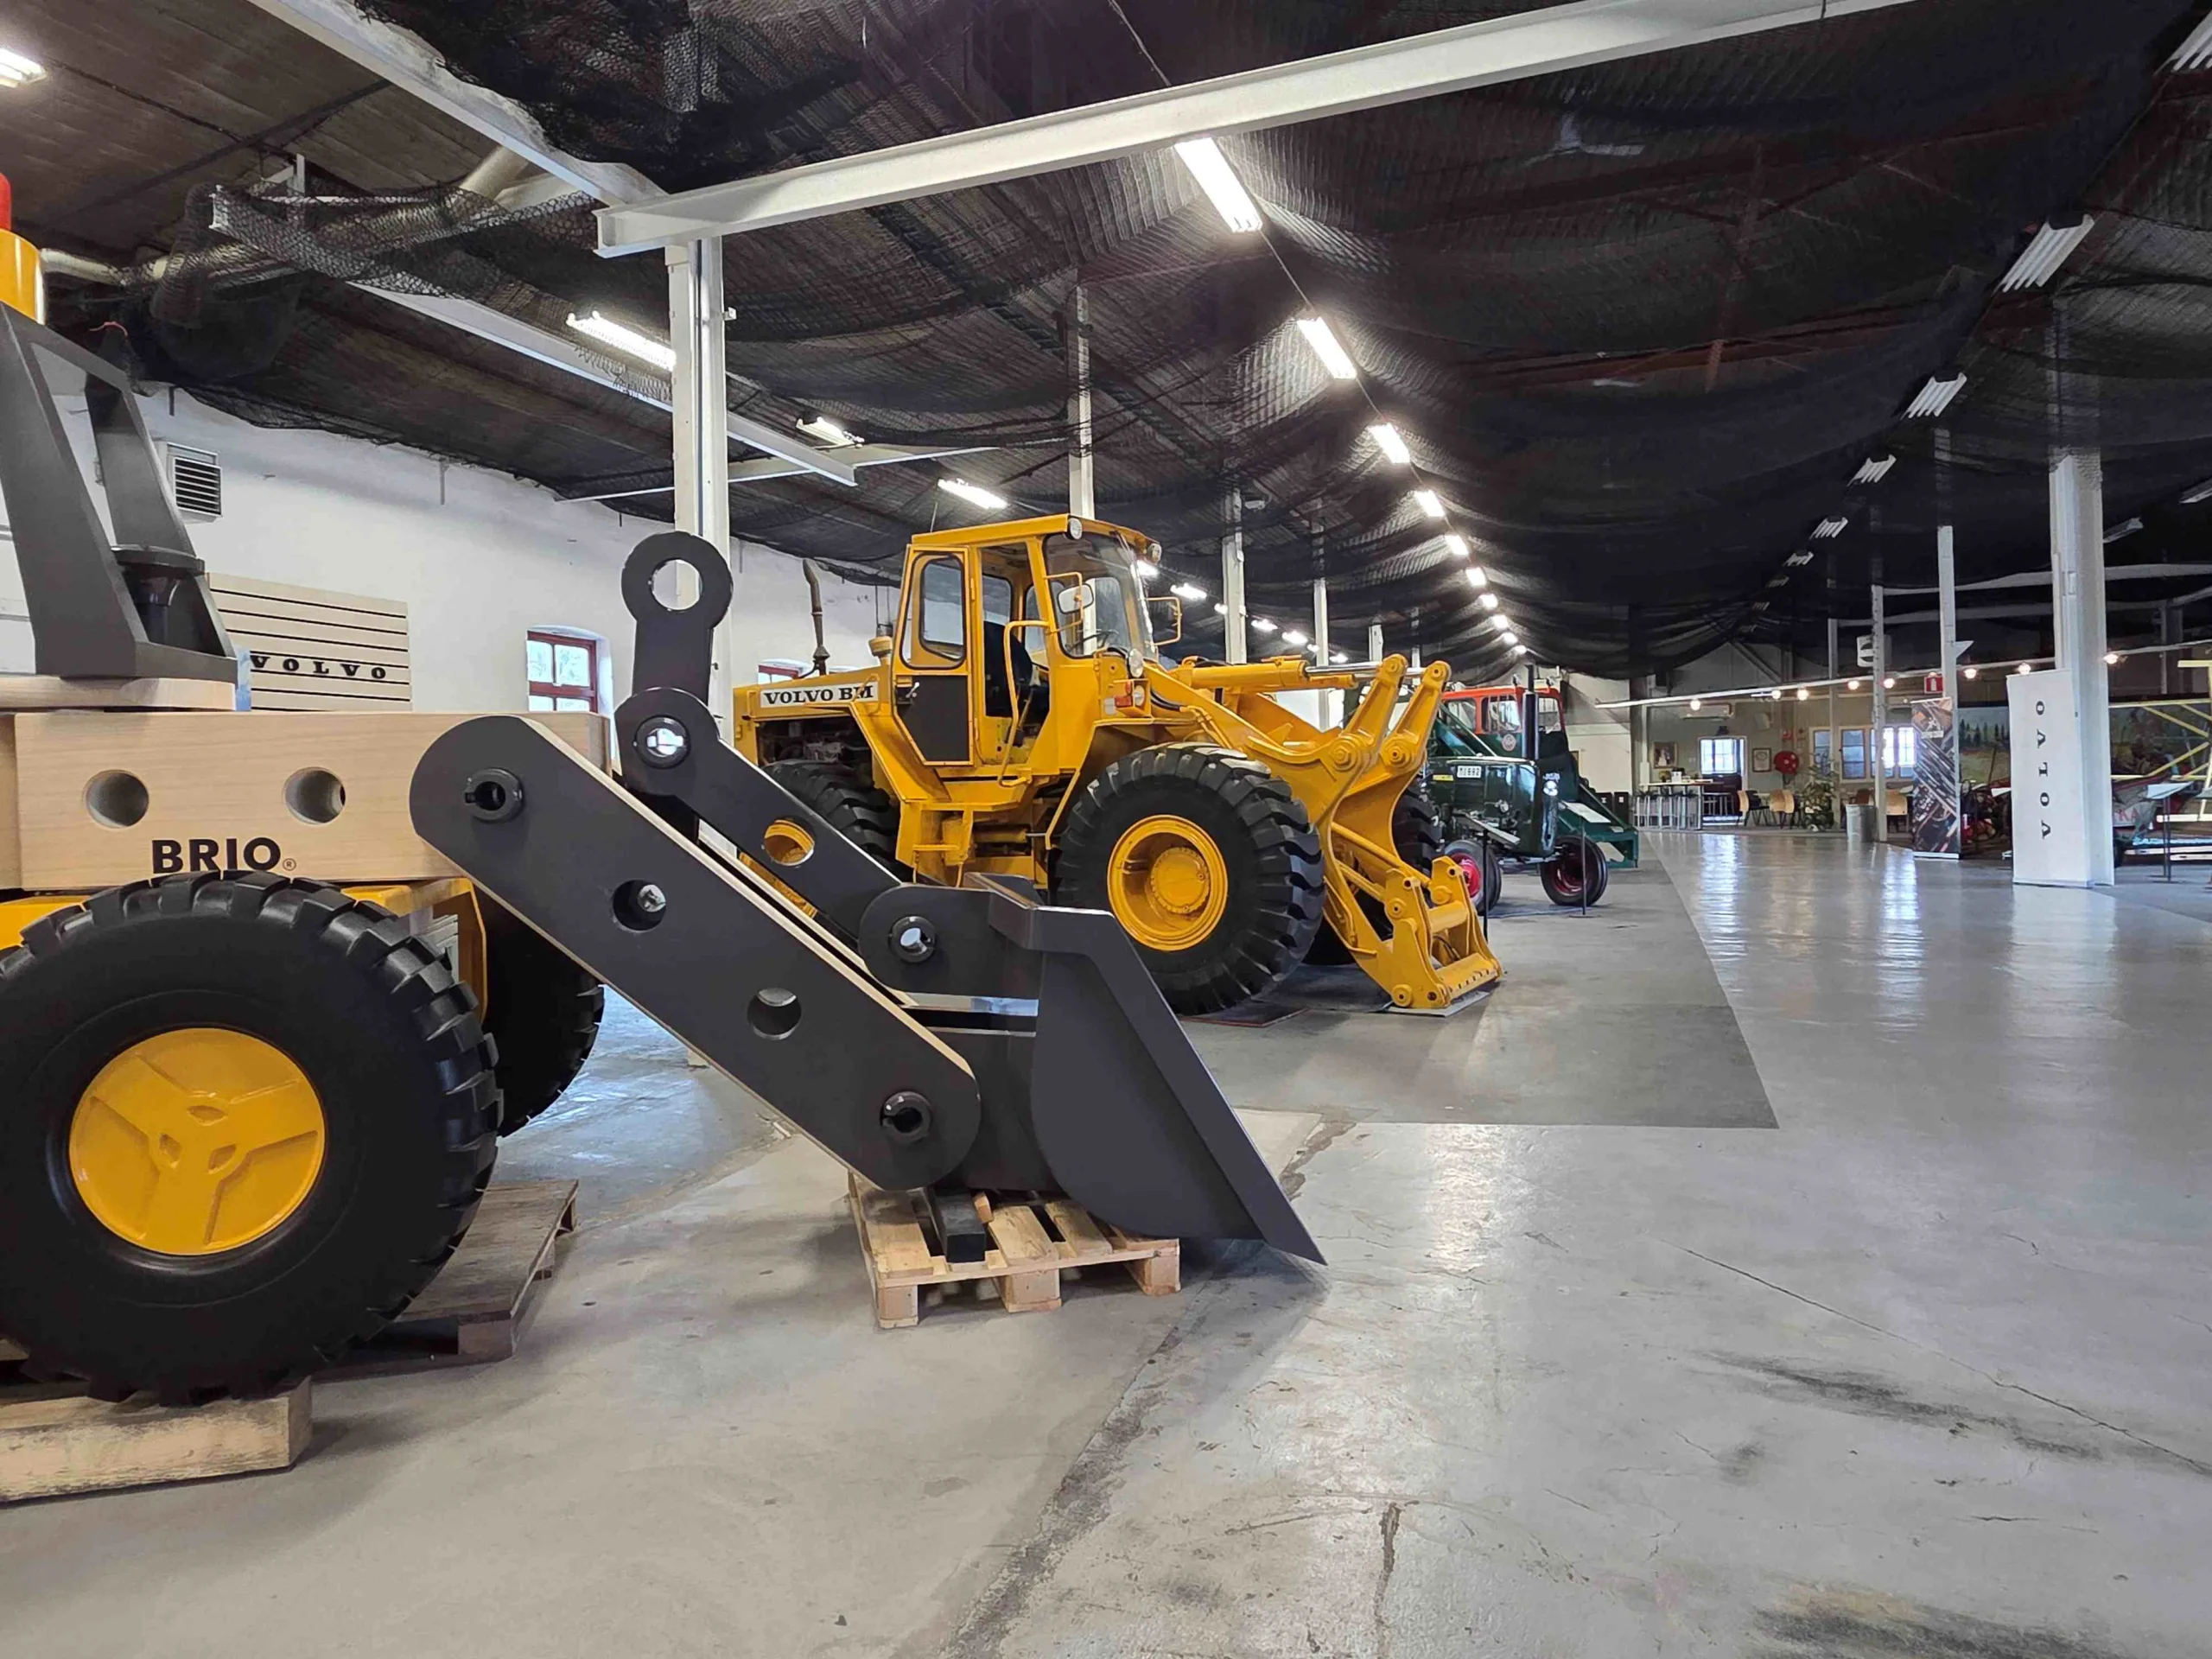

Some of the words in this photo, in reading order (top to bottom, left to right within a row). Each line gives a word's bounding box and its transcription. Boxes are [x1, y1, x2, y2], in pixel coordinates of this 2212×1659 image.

[250, 655, 386, 679] VOLVO
[764, 689, 834, 705] VOLVO
[838, 685, 874, 701] BM
[2035, 700, 2051, 840] VOLVO
